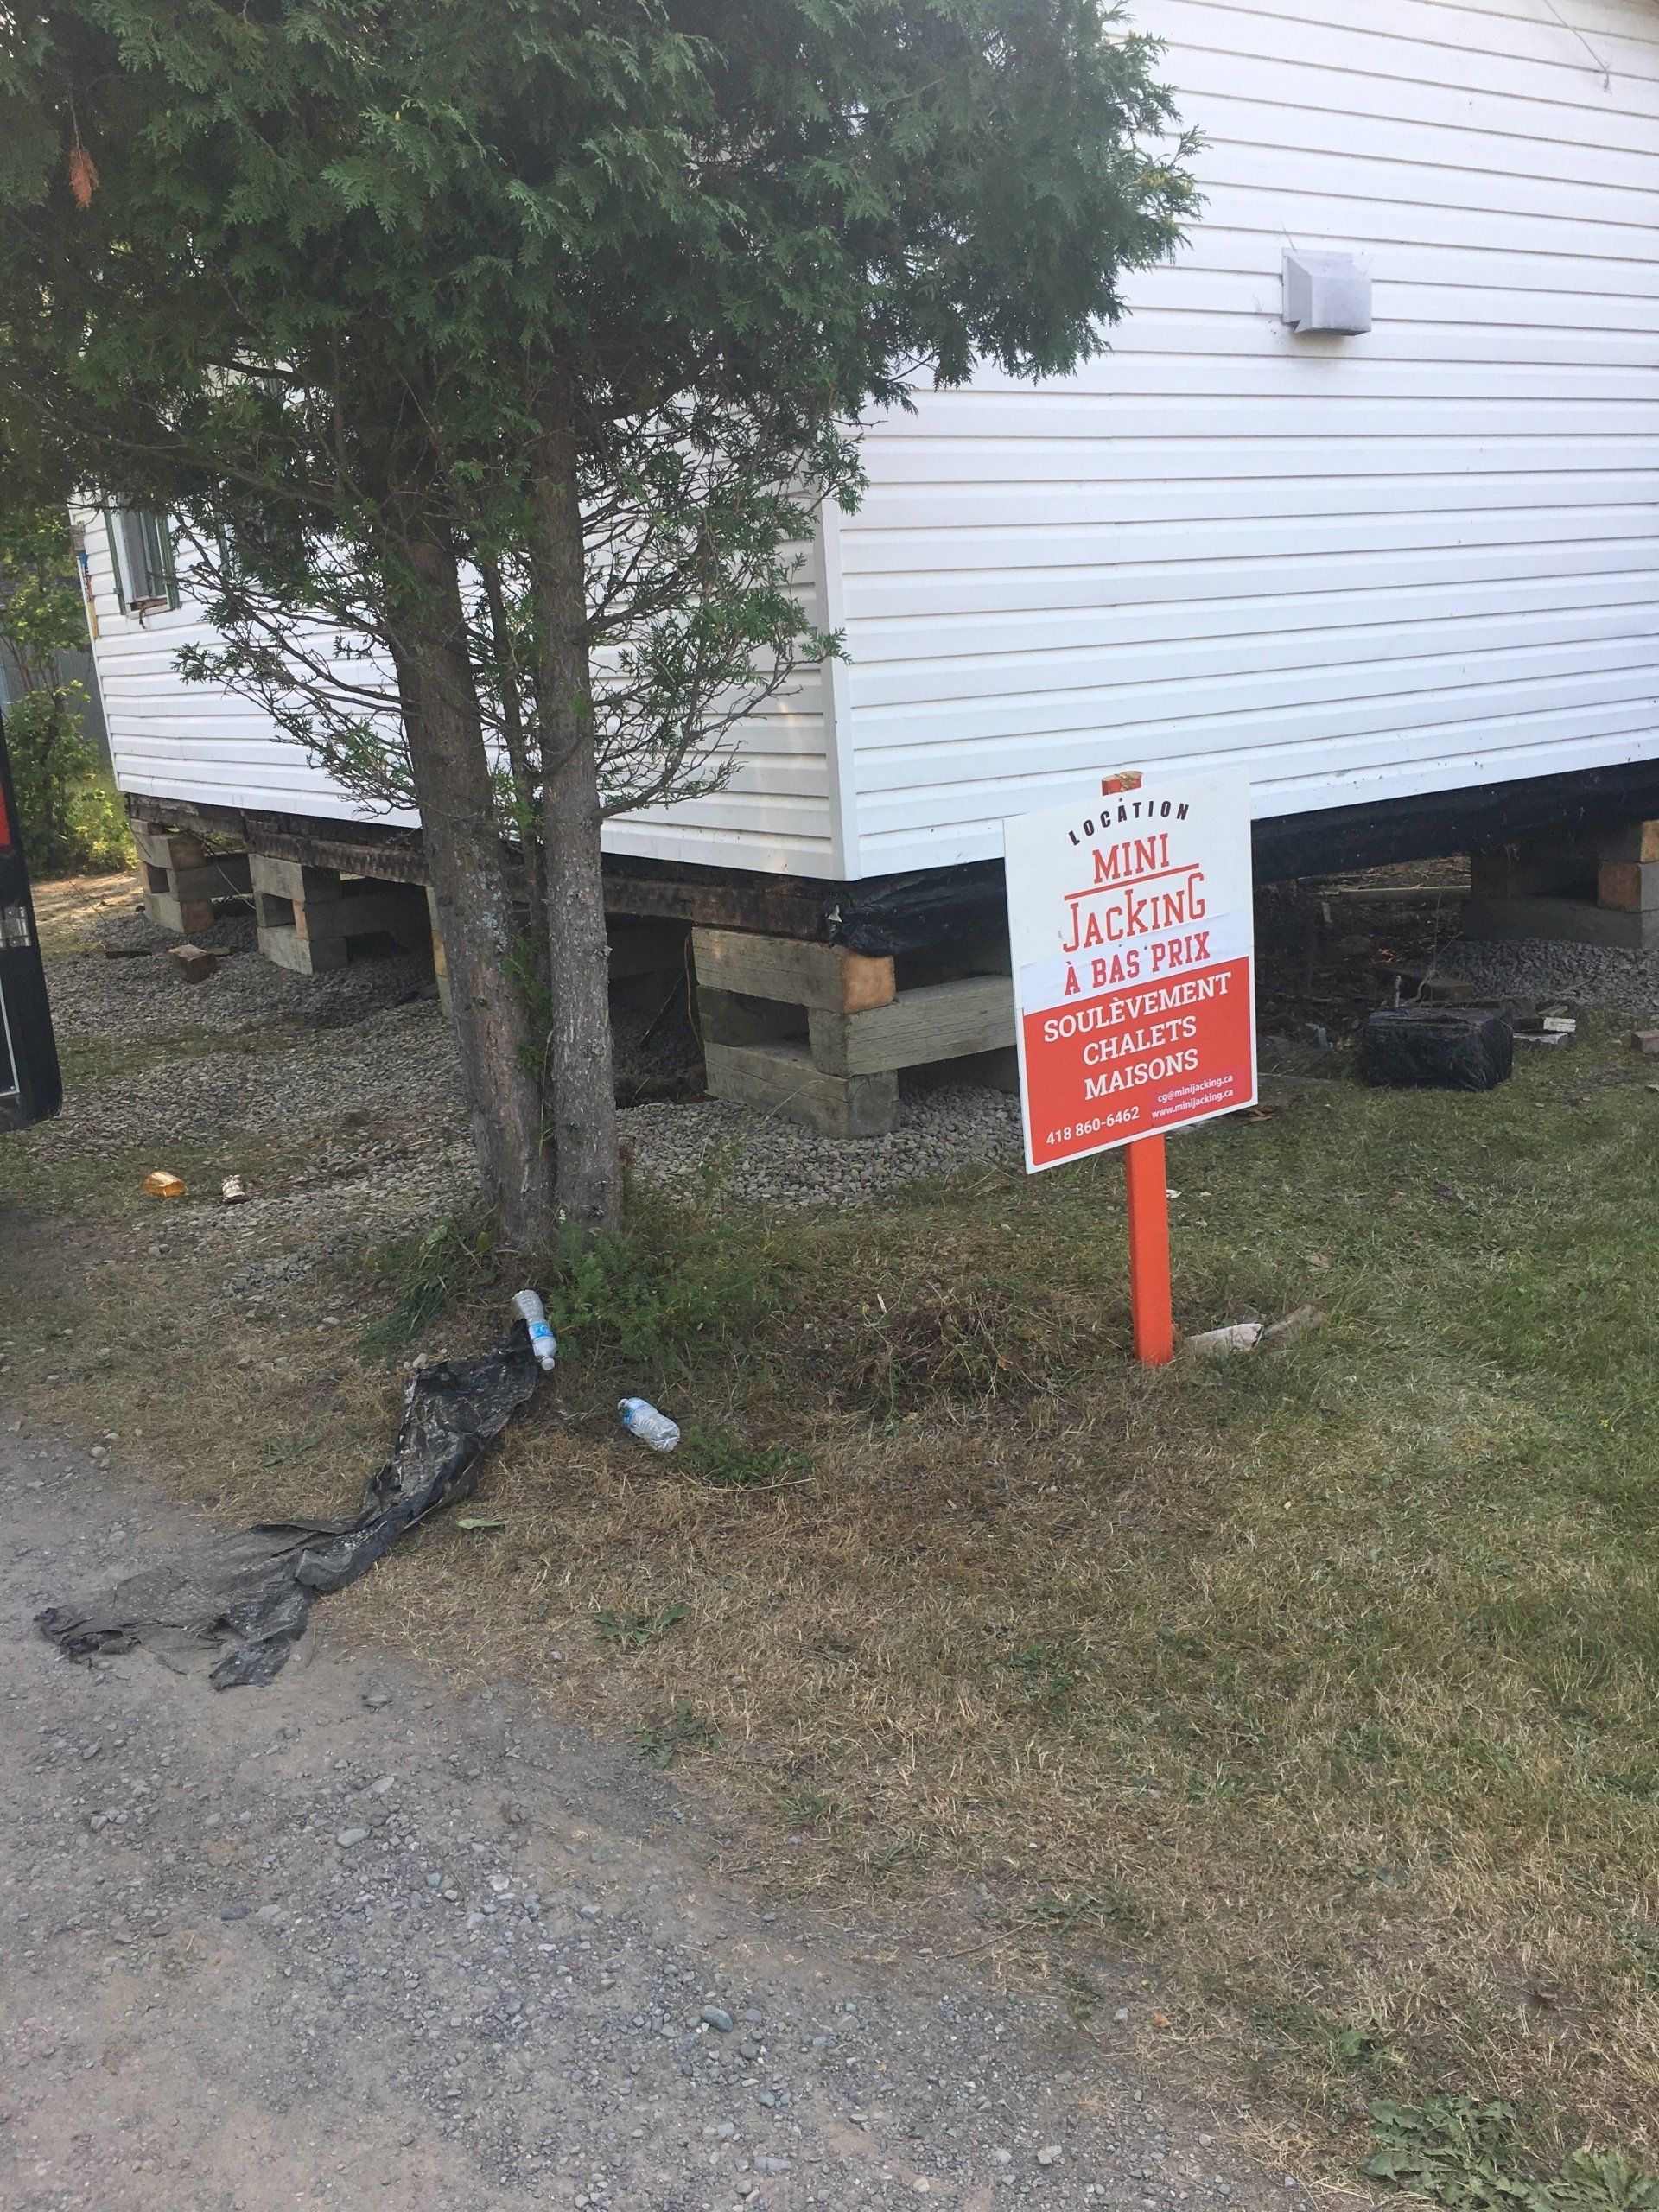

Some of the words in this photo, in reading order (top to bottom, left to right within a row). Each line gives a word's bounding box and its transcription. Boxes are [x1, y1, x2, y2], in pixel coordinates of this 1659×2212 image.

[1068, 800, 1190, 847] LOCATION
[1092, 832, 1170, 885] MINI
[1063, 872, 1206, 953] JACKING
[1064, 961, 1081, 996] À
[1092, 950, 1140, 989] BAS
[1151, 931, 1211, 973] PRIX
[1043, 971, 1232, 1043] SOULÈVEMENT
[1083, 1015, 1198, 1065] CHALETS
[1084, 1048, 1198, 1102] MAISONS
[1157, 1074, 1233, 1103] cg@minijacking.ca
[1046, 1126, 1072, 1146] 418
[1075, 1106, 1140, 1139] 860-6462
[1151, 1089, 1234, 1119] www.minijacking.ca
